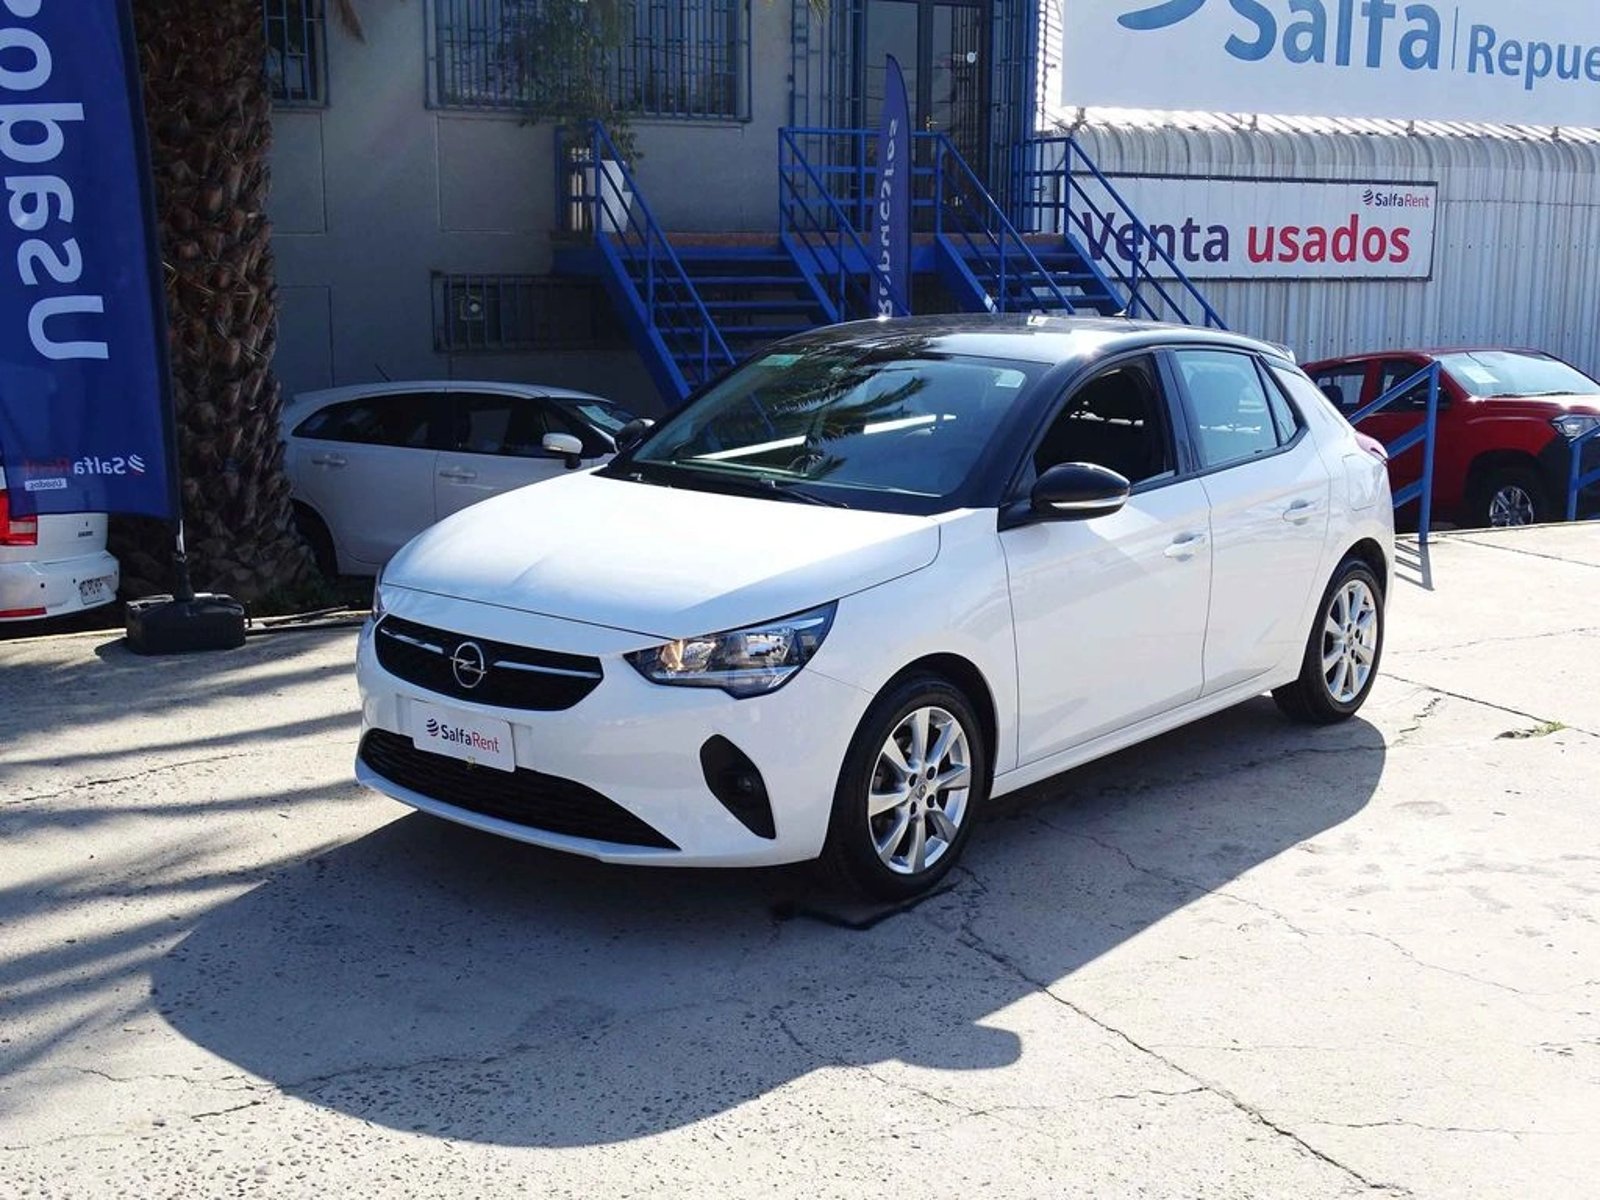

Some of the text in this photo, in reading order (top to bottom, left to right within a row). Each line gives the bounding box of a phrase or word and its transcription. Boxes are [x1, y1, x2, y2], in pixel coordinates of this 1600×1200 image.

[1225, 0, 1441, 69] Salfa
[1375, 193, 1429, 208] SalfaRent
[1082, 212, 1411, 263] Venta usados
[441, 724, 500, 753] SalfaRent
